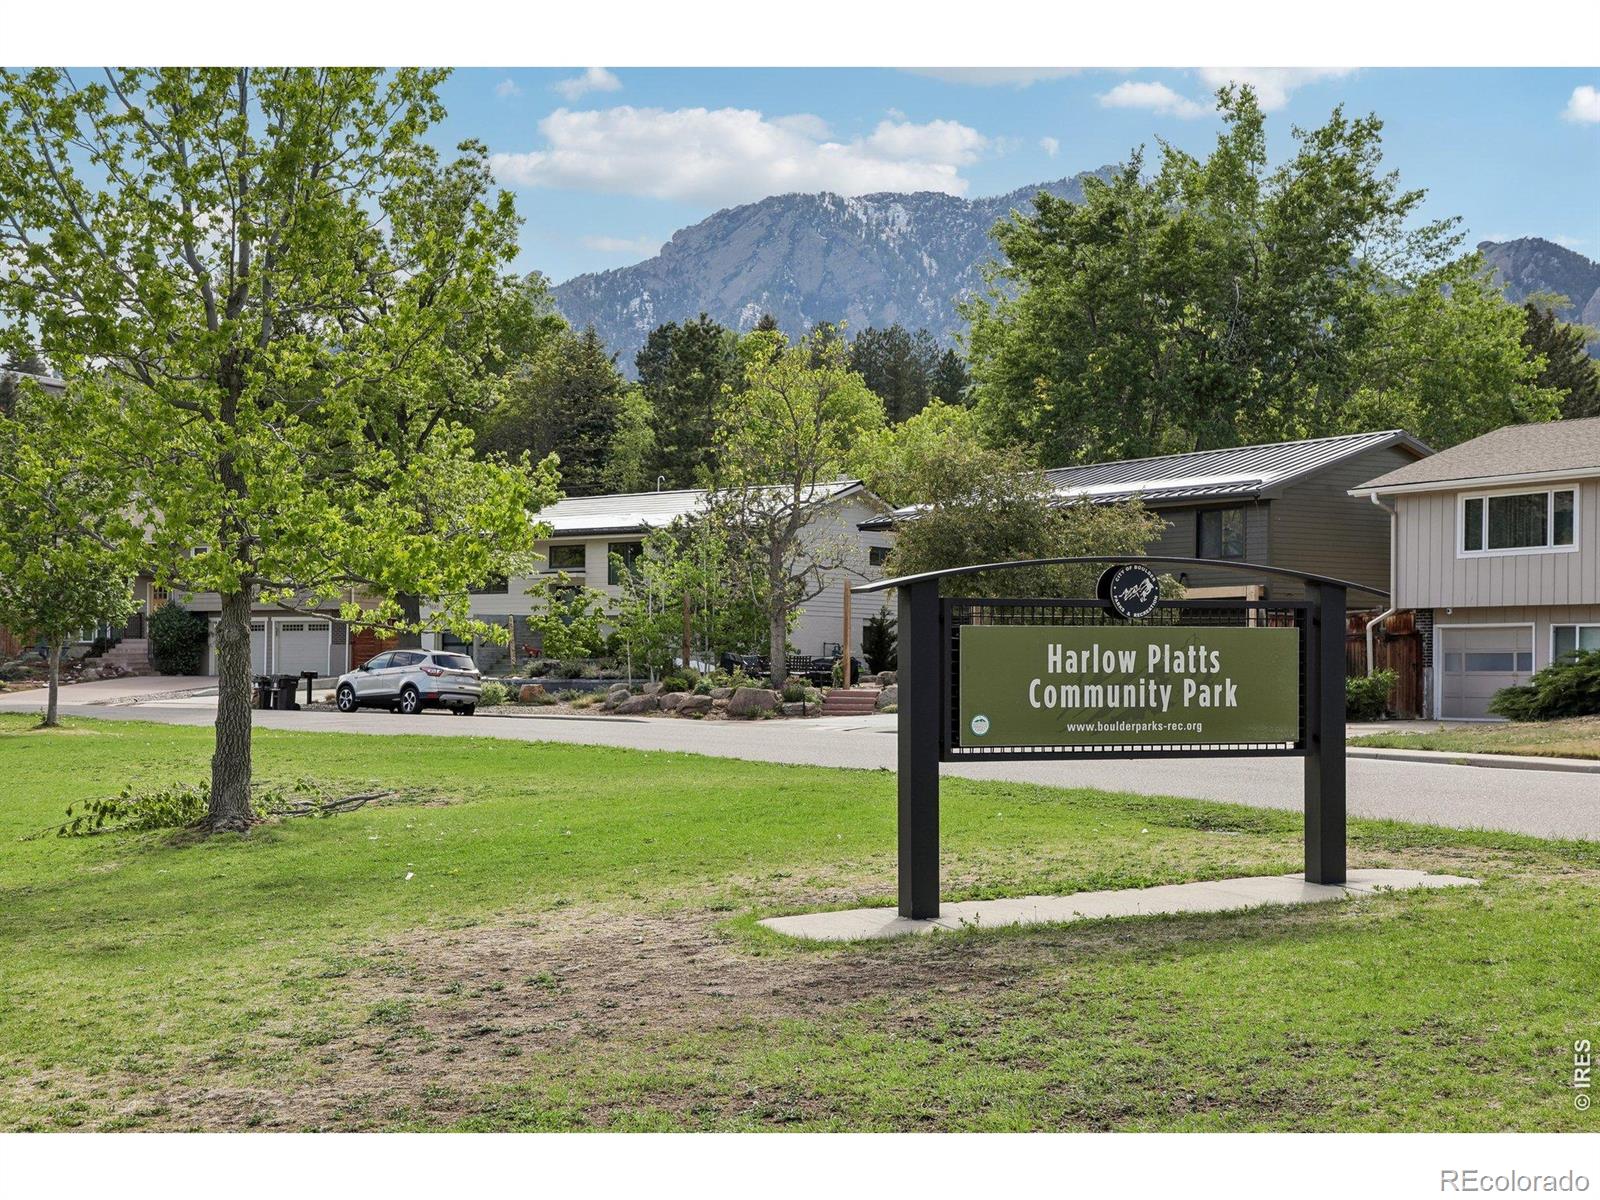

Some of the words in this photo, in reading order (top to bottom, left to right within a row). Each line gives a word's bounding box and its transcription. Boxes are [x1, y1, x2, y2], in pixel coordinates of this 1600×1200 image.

[1134, 565, 1156, 582] BOULDER
[1047, 644, 1137, 674] Harlow
[1148, 644, 1221, 674] Platts
[1028, 678, 1173, 712] Community
[1183, 678, 1238, 707] Park
[1067, 721, 1203, 733] www.boulderparks-rec.org
